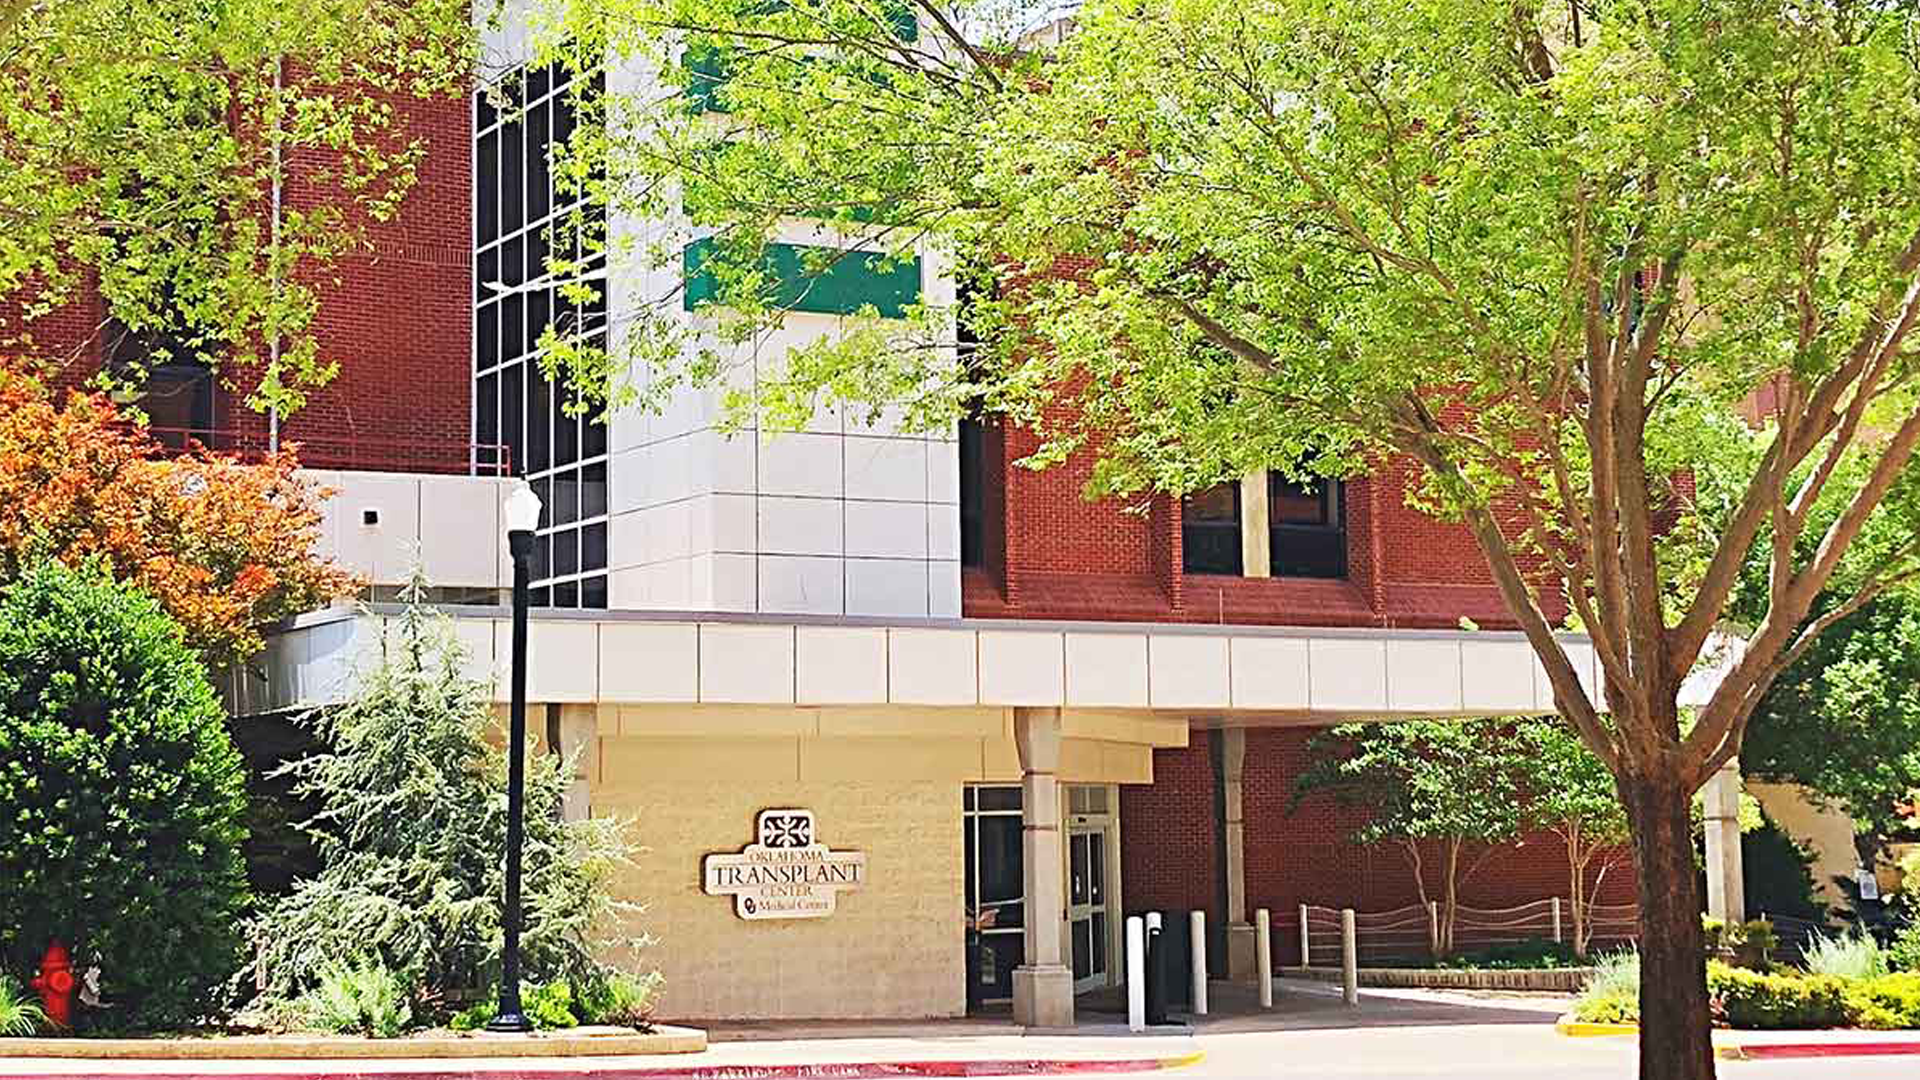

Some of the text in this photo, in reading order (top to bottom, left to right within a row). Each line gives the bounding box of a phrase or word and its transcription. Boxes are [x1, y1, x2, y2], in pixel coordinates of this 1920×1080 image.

[749, 850, 823, 862] OKLAHOMA
[714, 863, 863, 885] TRANSPLANT
[760, 885, 813, 897] CENTER
